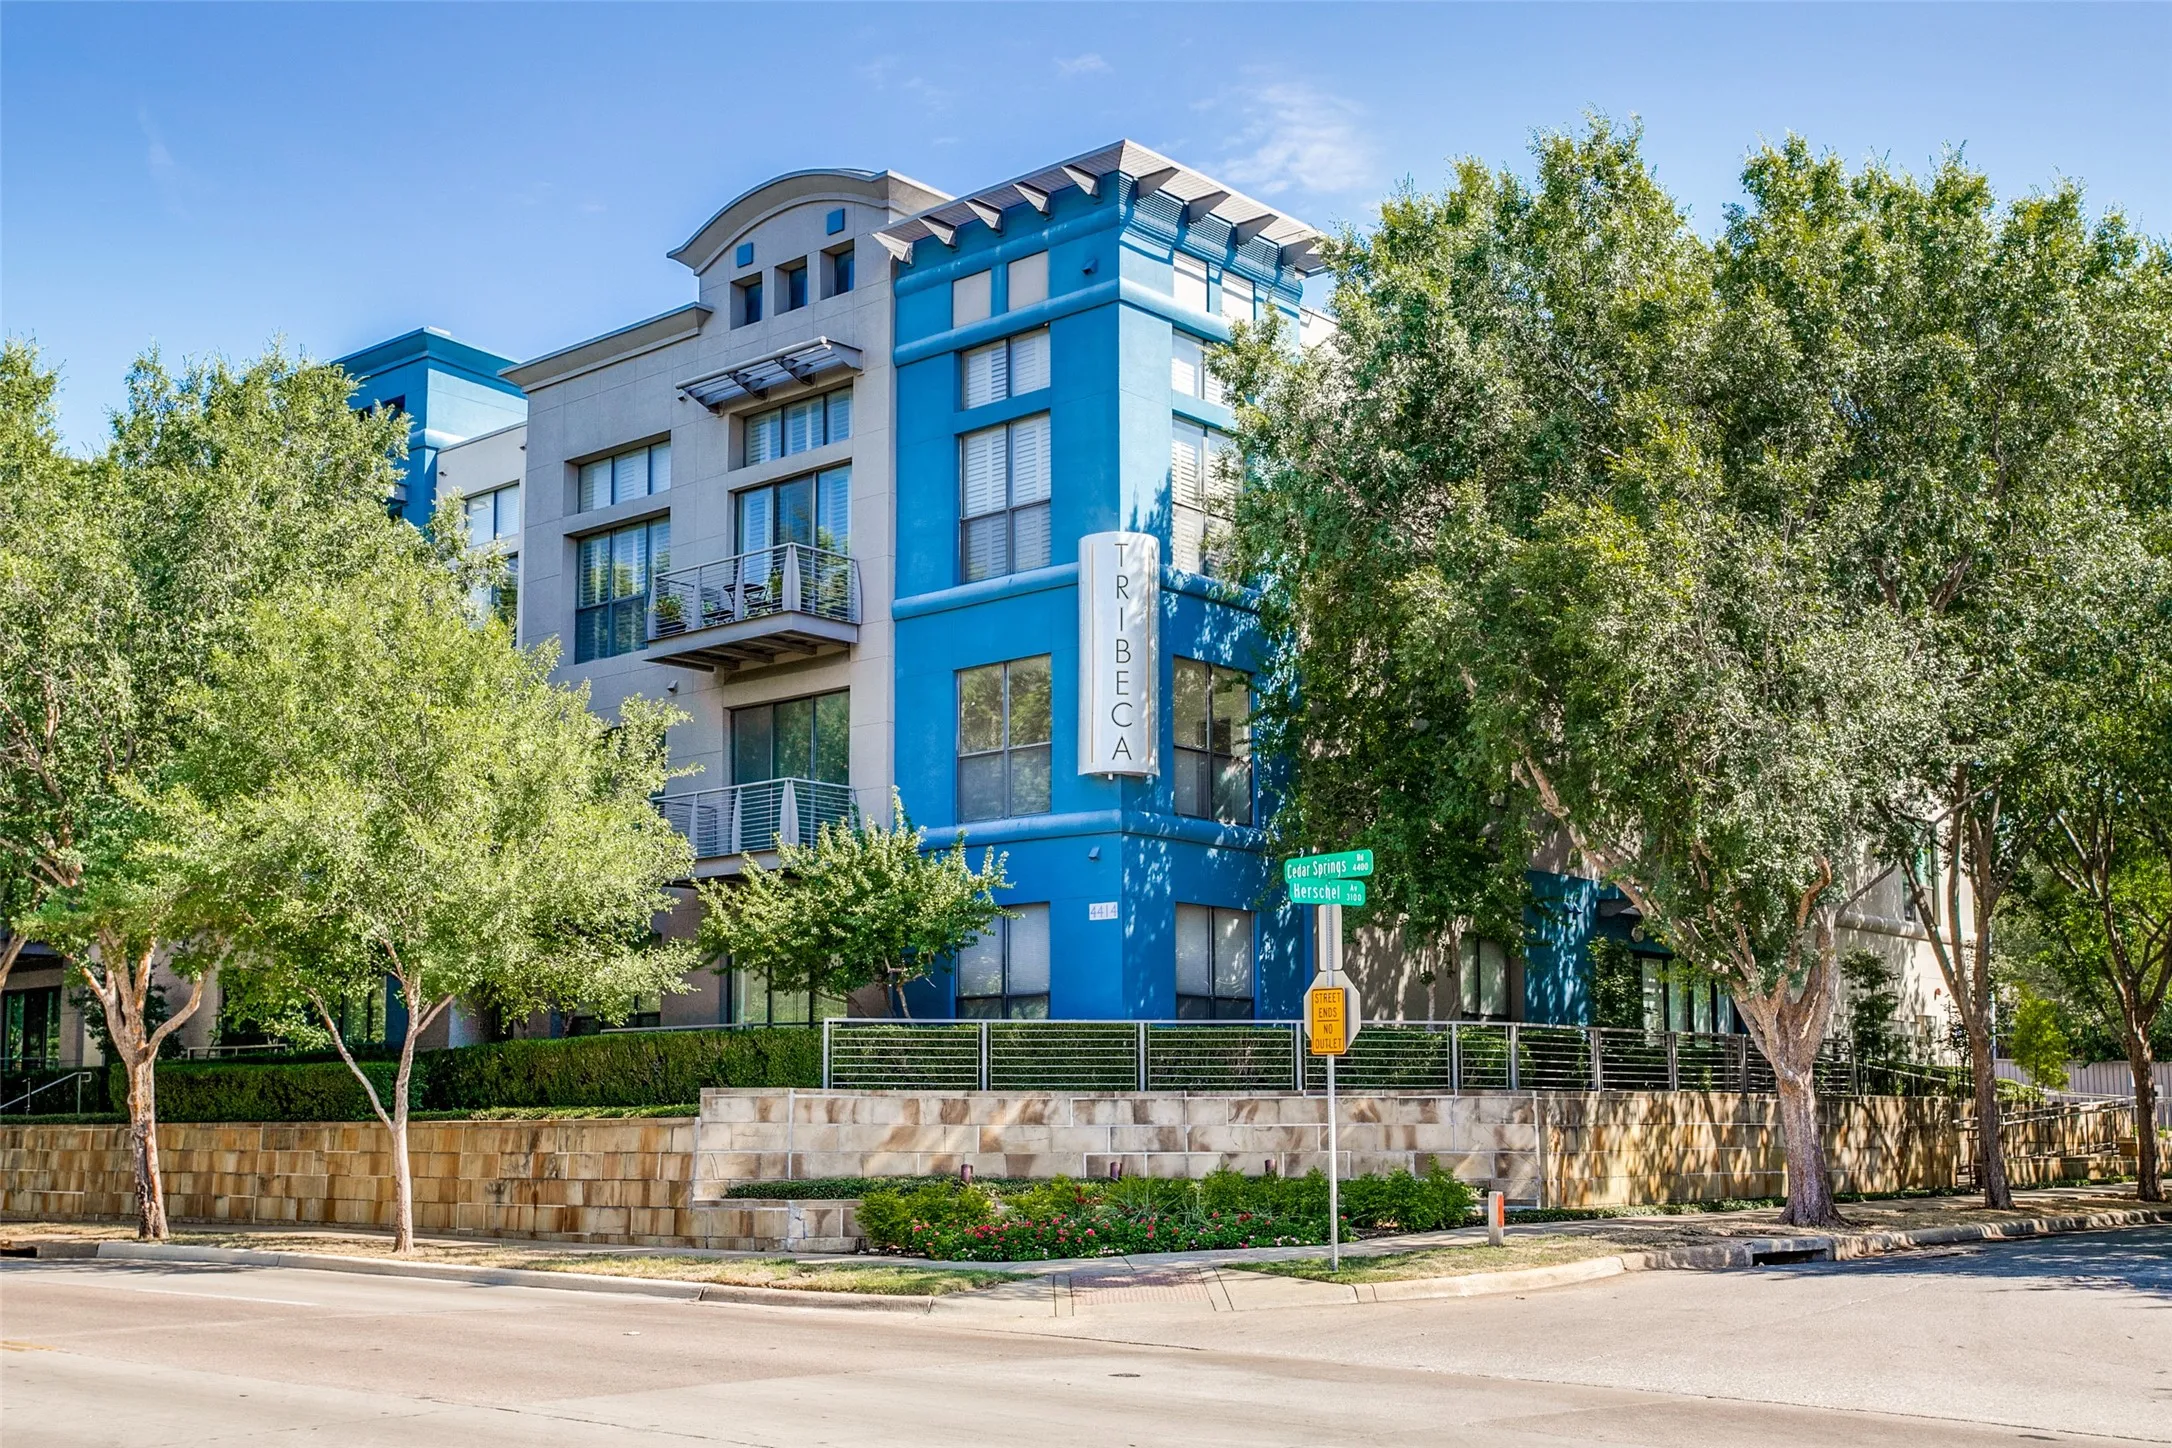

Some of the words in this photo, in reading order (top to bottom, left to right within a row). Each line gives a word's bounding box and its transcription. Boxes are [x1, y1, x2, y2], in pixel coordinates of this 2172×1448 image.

[1111, 543, 1133, 761] TRIBECA
[1356, 853, 1364, 862] Rd
[1287, 864, 1310, 879] Cedar
[1313, 860, 1347, 878] Springs
[1352, 862, 1369, 872] 4400
[1293, 883, 1340, 900] Herschel
[1350, 884, 1358, 892] Av
[1346, 893, 1362, 902] 3100
[1090, 904, 1117, 918] 4414
[1315, 992, 1341, 1004] STREET
[1318, 1007, 1337, 1018] ENDS
[1323, 1023, 1333, 1034] NO
[1315, 1038, 1341, 1049] OUTLET
